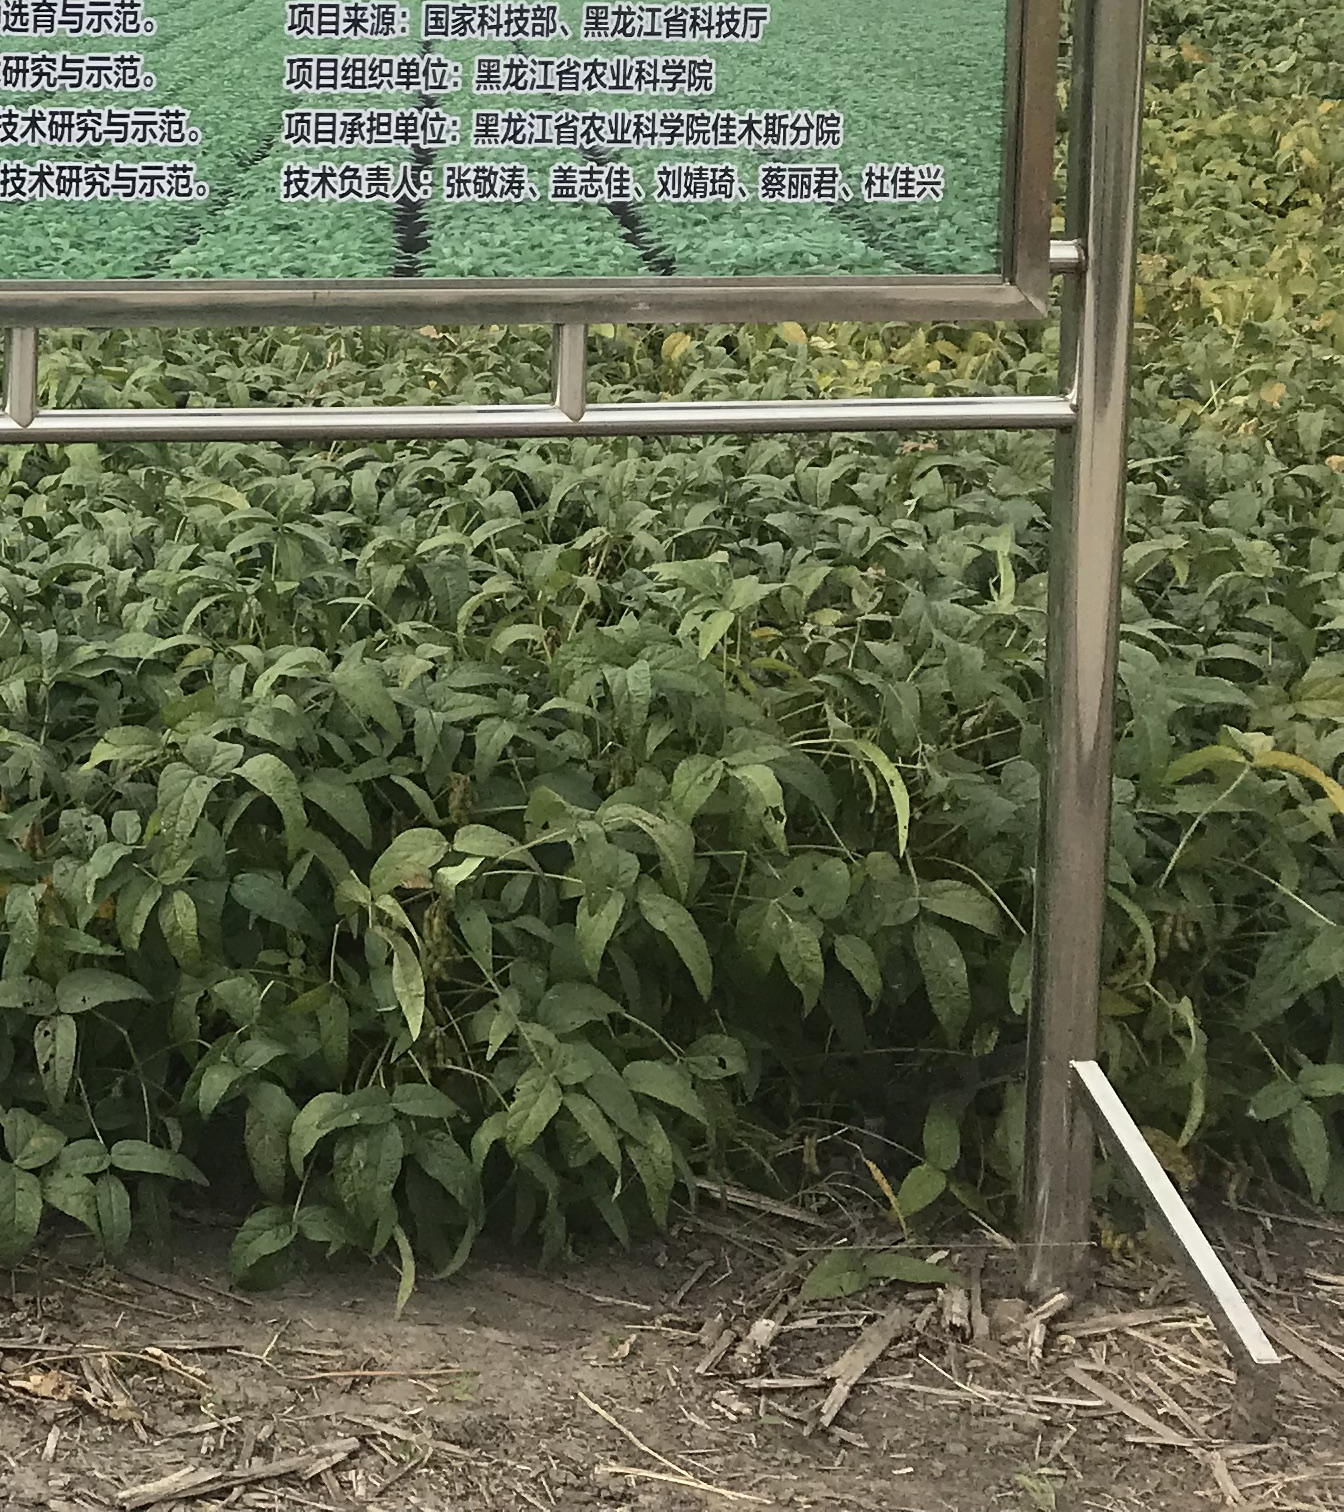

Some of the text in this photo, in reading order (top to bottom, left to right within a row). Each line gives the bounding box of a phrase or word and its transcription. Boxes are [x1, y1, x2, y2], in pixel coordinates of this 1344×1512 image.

[288, 2, 768, 39] 项目来源：国家科技部、黑龙江省科技厅
[286, 57, 713, 92] 项目组织单位：黑龙江省农业科学院
[284, 111, 841, 146] 项目承担单位：黑龙江省农业科学院佳木斯分院
